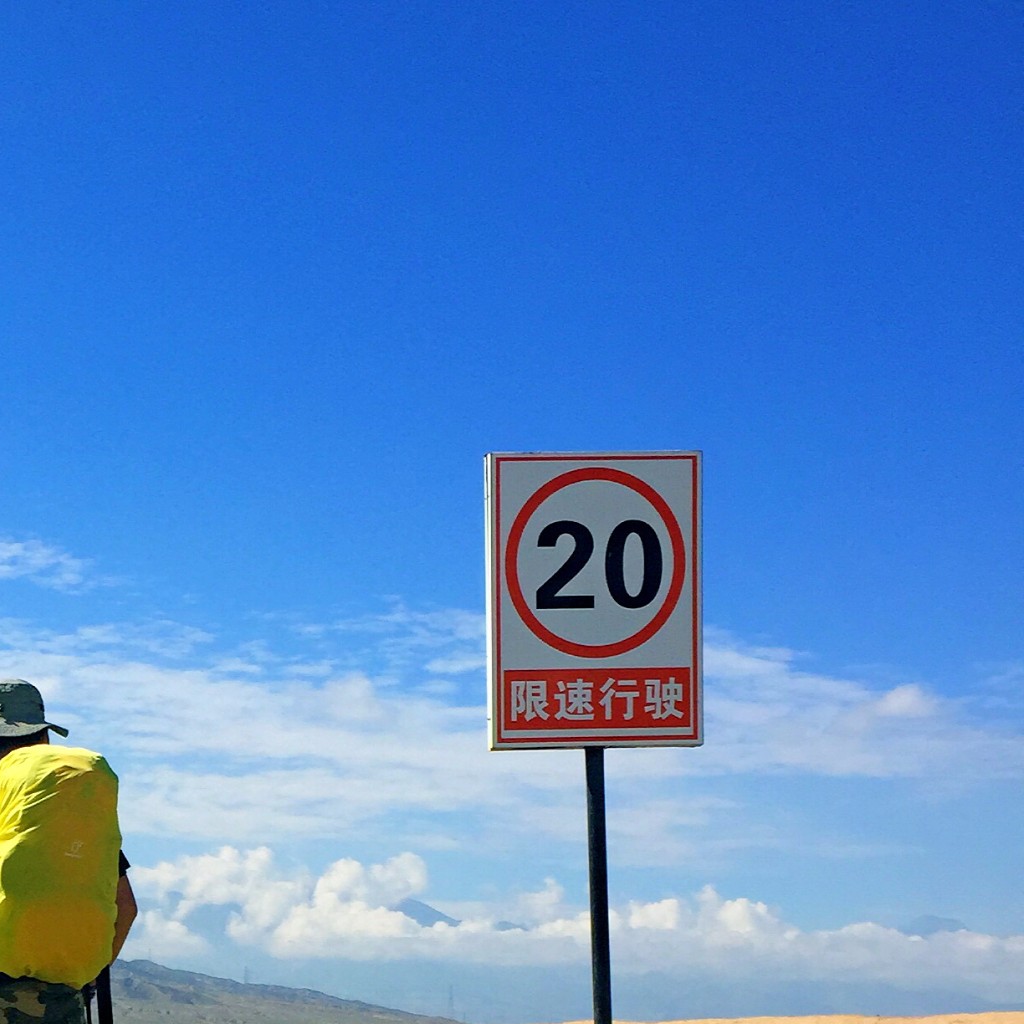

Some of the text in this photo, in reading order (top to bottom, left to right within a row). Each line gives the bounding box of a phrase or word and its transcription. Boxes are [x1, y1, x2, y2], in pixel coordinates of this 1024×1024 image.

[536, 519, 663, 609] 20
[510, 677, 685, 722] 限速行驶
